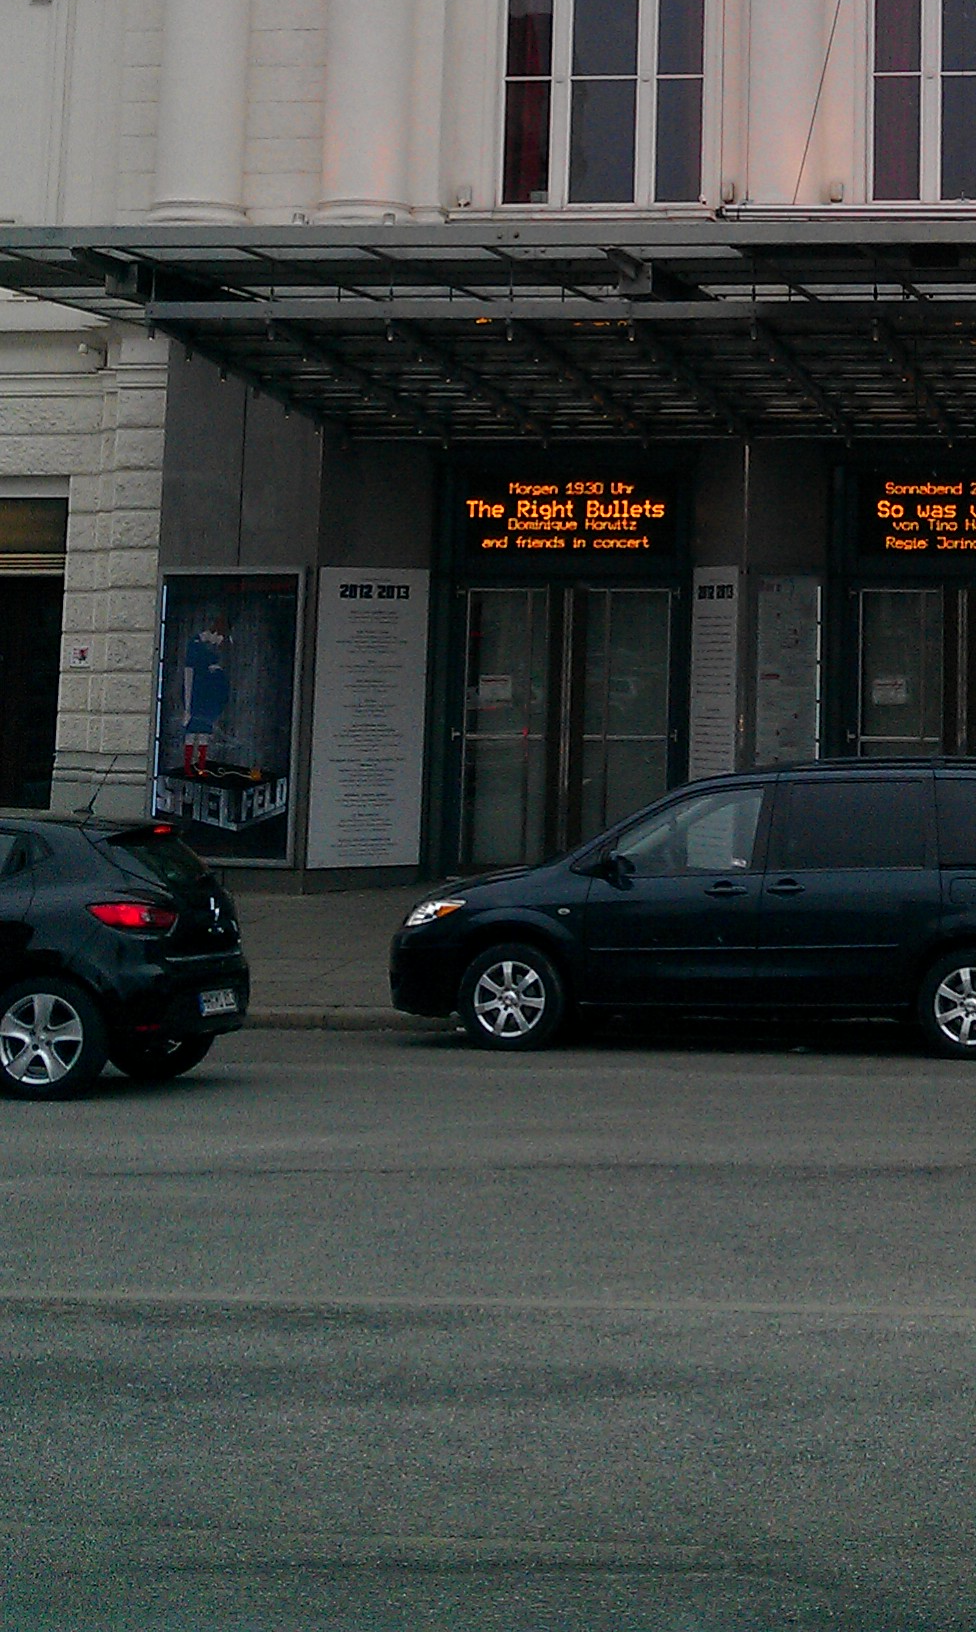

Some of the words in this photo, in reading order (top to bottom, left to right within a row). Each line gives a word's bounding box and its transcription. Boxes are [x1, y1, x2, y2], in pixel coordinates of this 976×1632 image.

[509, 482, 558, 496] Morgen
[611, 483, 634, 494] Uhr
[885, 482, 962, 495] Sonnabend
[467, 500, 505, 518] The
[517, 500, 573, 519] Right
[586, 500, 665, 518] Bullets
[878, 501, 904, 518] So
[918, 505, 956, 518] was
[508, 518, 577, 531] Dominique
[585, 519, 637, 531] Horwitz
[893, 522, 919, 531] von
[928, 520, 958, 531] Tino
[482, 537, 507, 548] and
[516, 536, 565, 548] friends
[573, 537, 585, 548] in
[593, 536, 650, 548] concert
[340, 584, 373, 599] 2012
[377, 584, 410, 599] 2013
